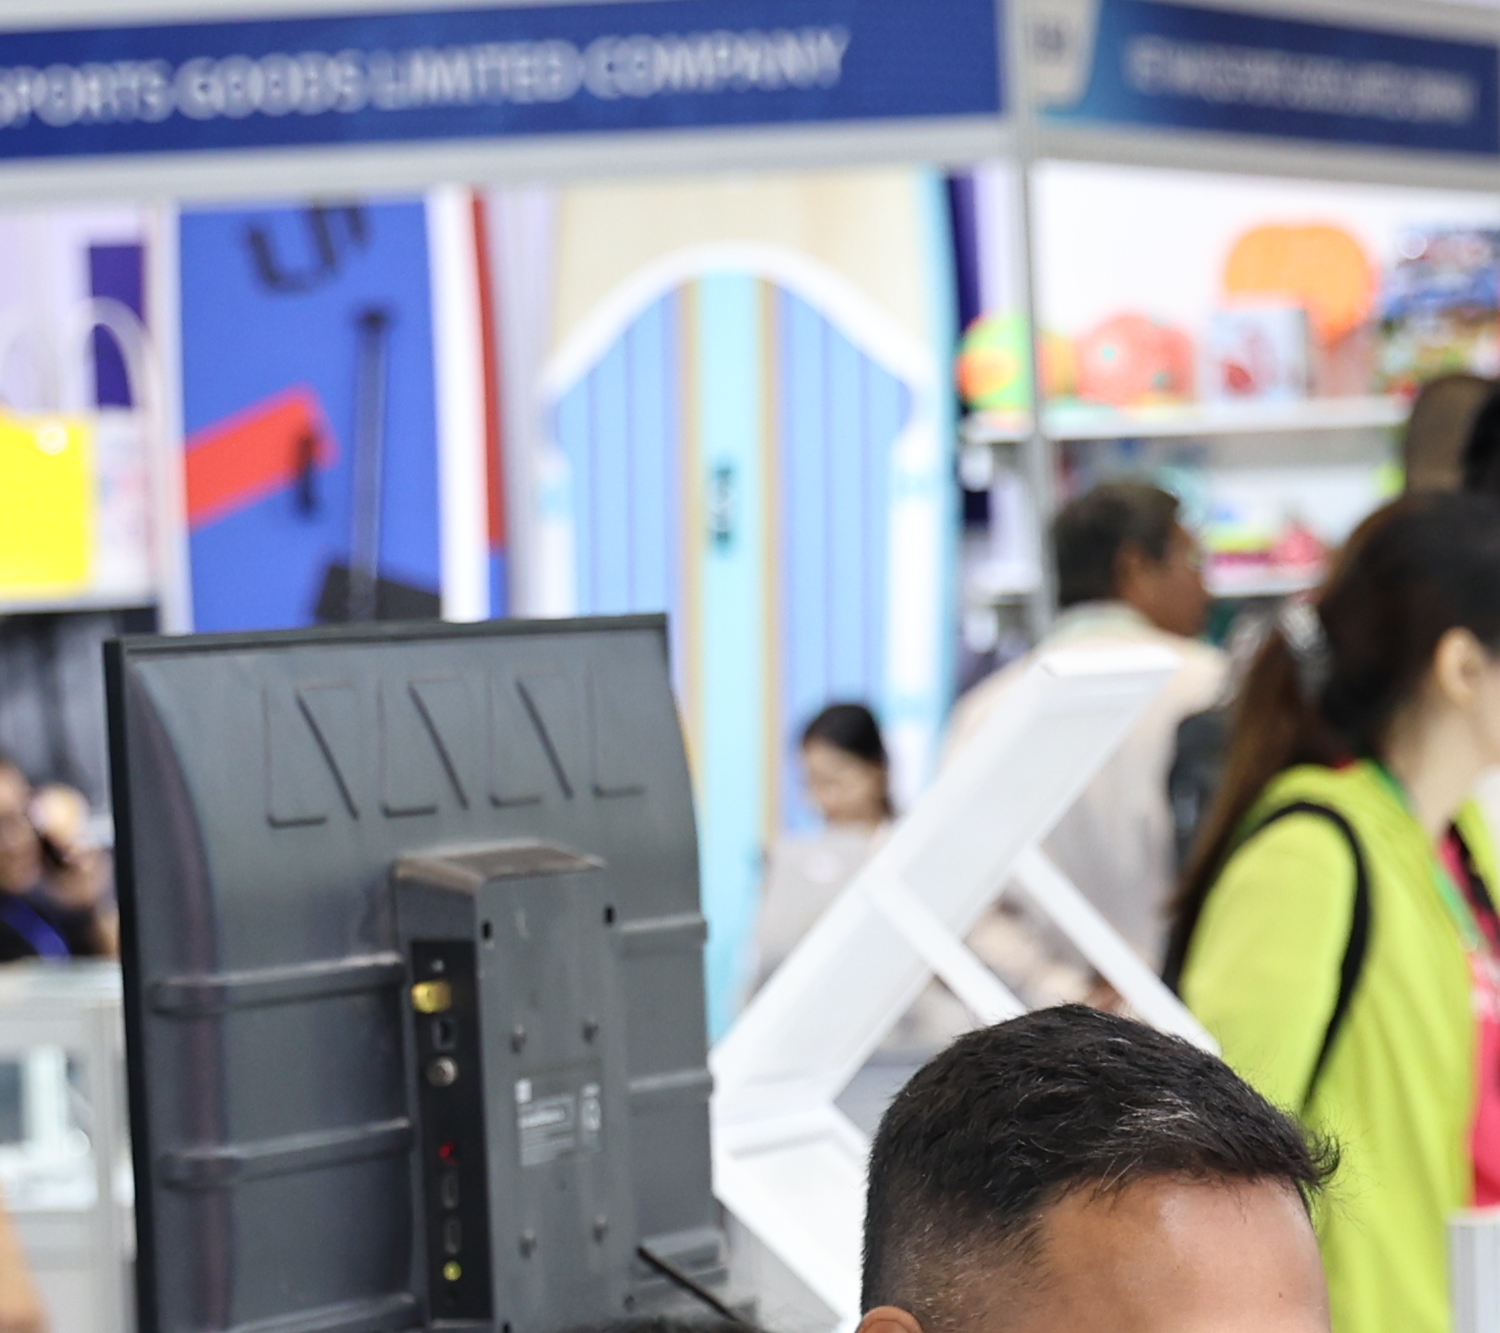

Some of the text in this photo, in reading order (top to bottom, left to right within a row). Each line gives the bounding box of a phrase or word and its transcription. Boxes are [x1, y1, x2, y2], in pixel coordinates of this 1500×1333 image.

[177, 53, 363, 117] GOODS
[372, 42, 580, 107] LIMITED
[586, 30, 848, 96] COMPANY
